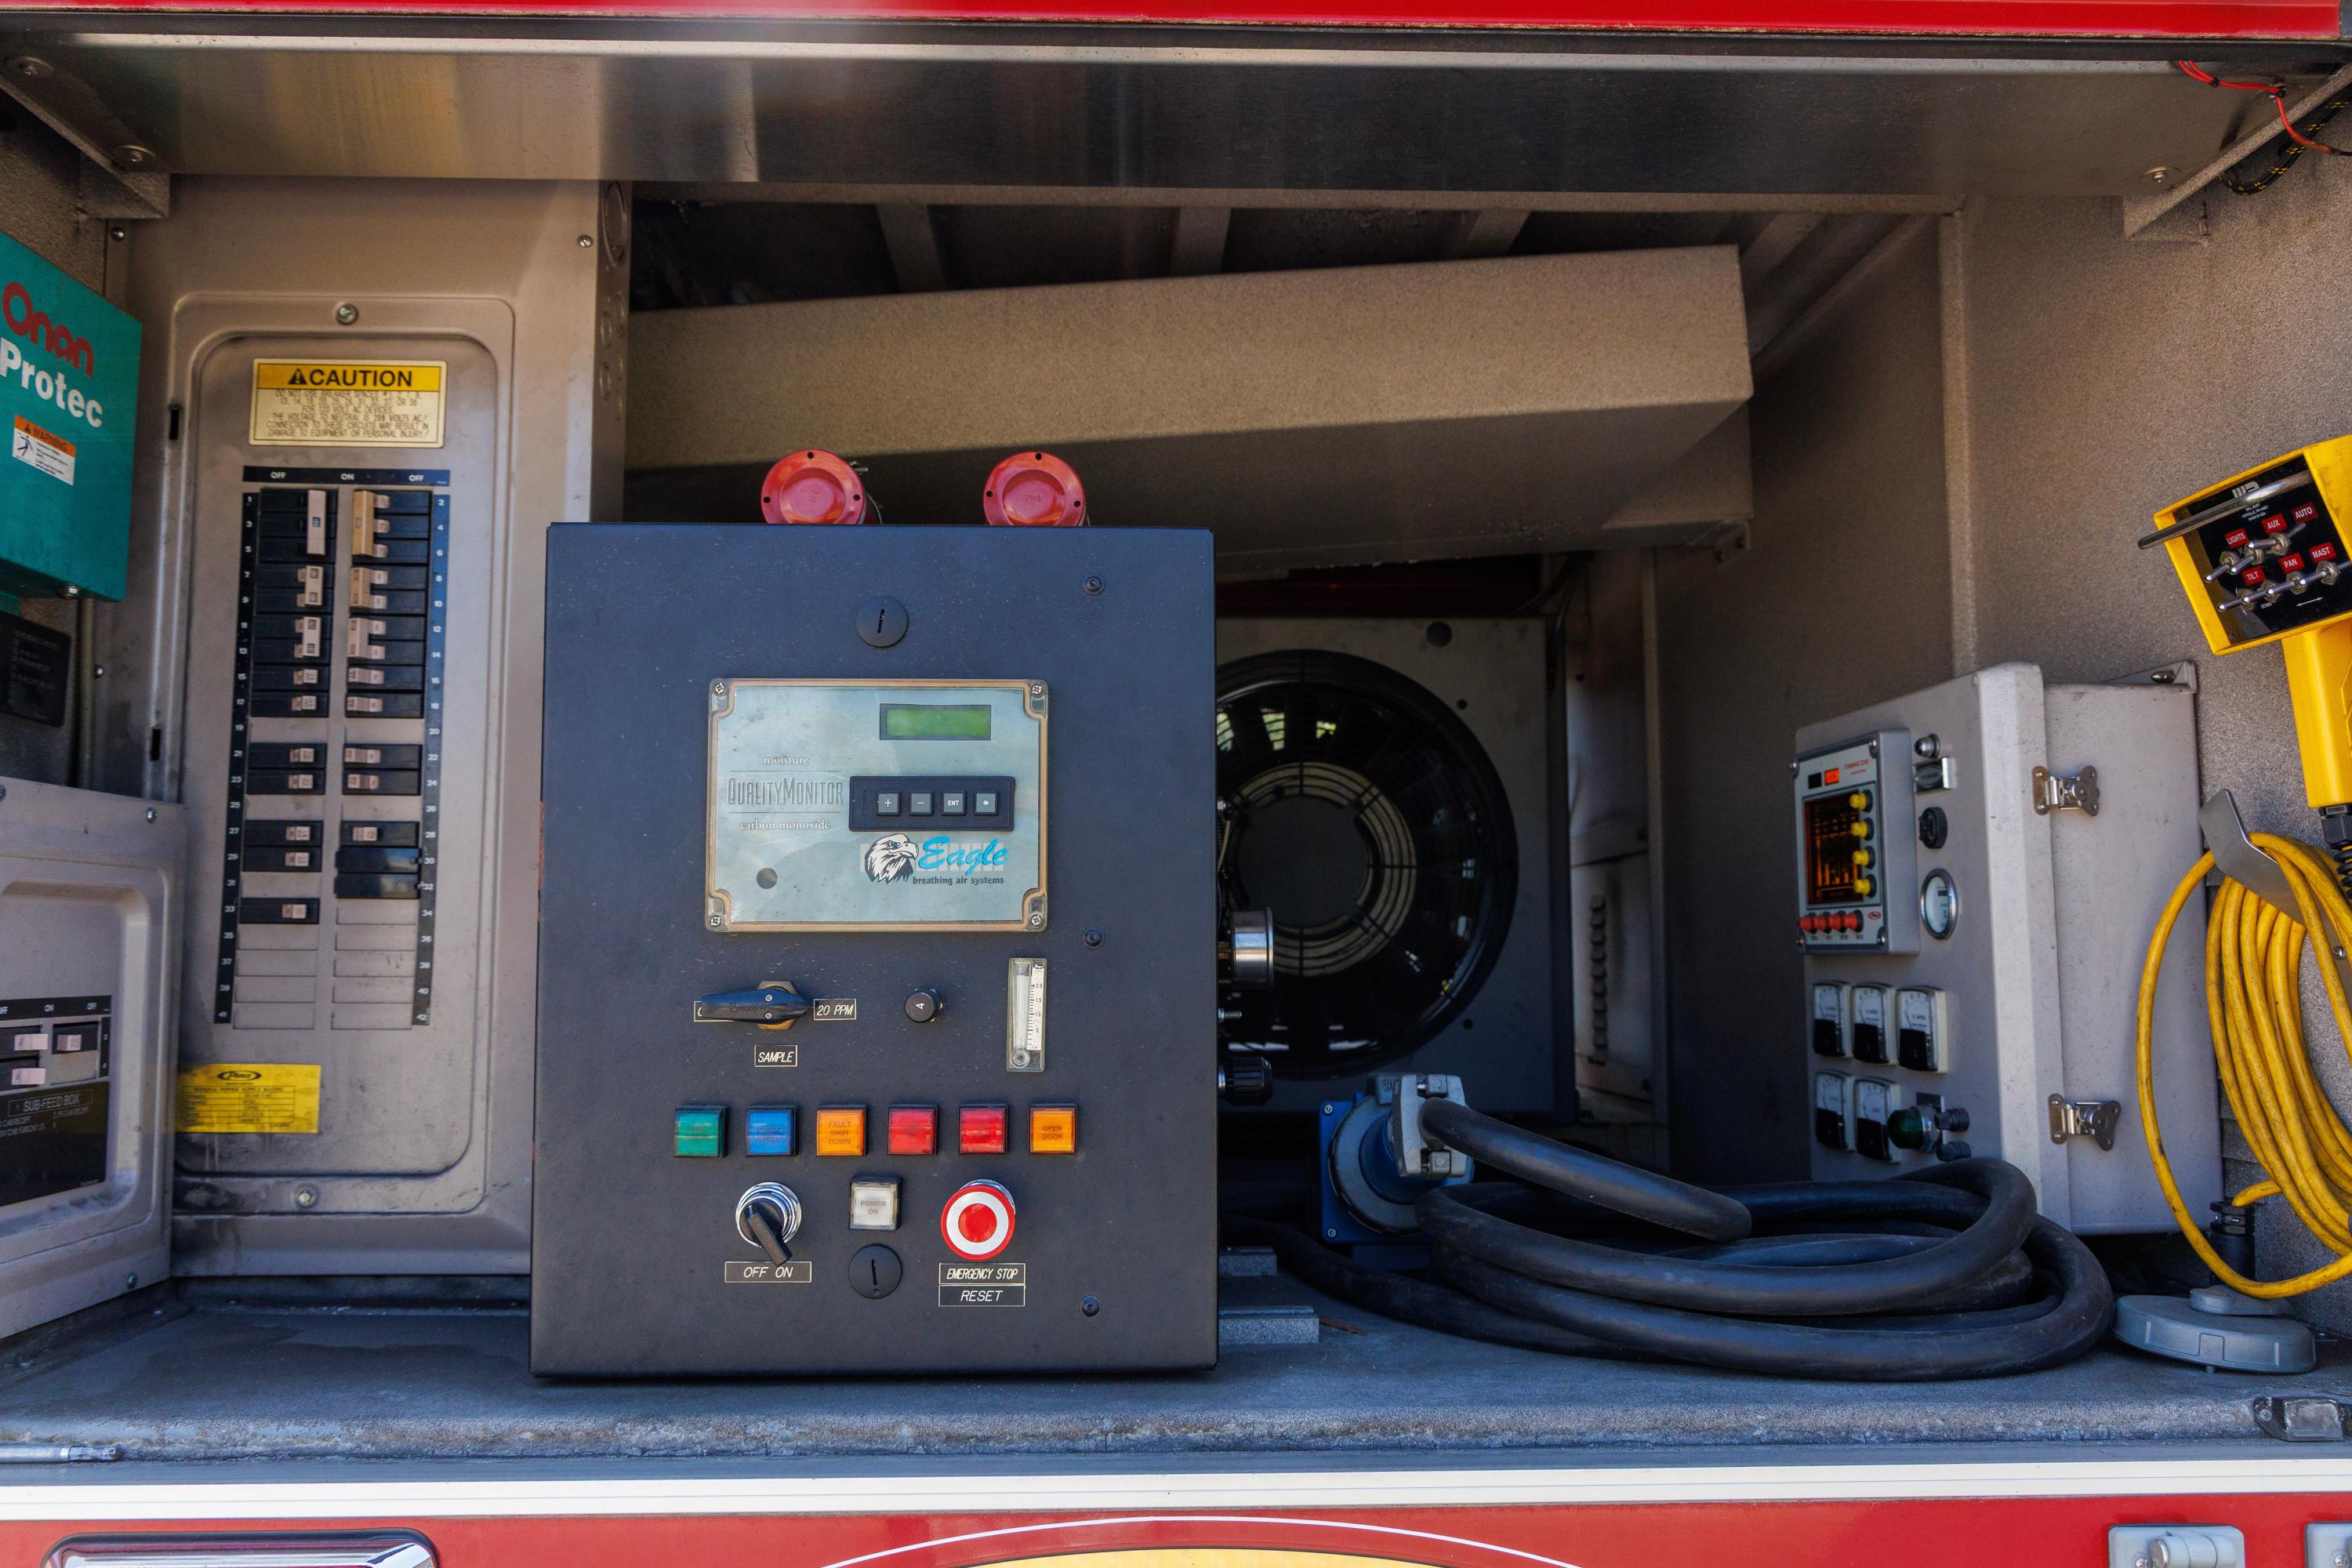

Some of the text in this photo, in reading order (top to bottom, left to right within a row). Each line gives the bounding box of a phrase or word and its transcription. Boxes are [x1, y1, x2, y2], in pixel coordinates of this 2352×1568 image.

[2, 281, 94, 377] Onan
[0, 337, 103, 427] Protec
[309, 368, 412, 387] CAUTION
[2295, 506, 2313, 519] AUTO
[2267, 520, 2281, 529] AUX
[2227, 532, 2245, 545] LIGHTS
[2312, 546, 2331, 558] MAST
[2284, 558, 2297, 568] PAN
[2246, 572, 2259, 581] TILT
[764, 754, 809, 765] moisture
[740, 819, 831, 830] carbon monoxide
[917, 835, 1010, 877] Eagle
[913, 877, 953, 886] breathing
[971, 877, 1004, 886] systems
[817, 1004, 854, 1016] 20 PPM
[757, 1051, 794, 1063] SAMPLE
[24, 1096, 63, 1112] SUB-FEED
[63, 1093, 81, 1106] BOX
[743, 1266, 793, 1278] OFF ON
[946, 1269, 1018, 1279] EMERGENCY STOP
[960, 1290, 1003, 1302] RESET
